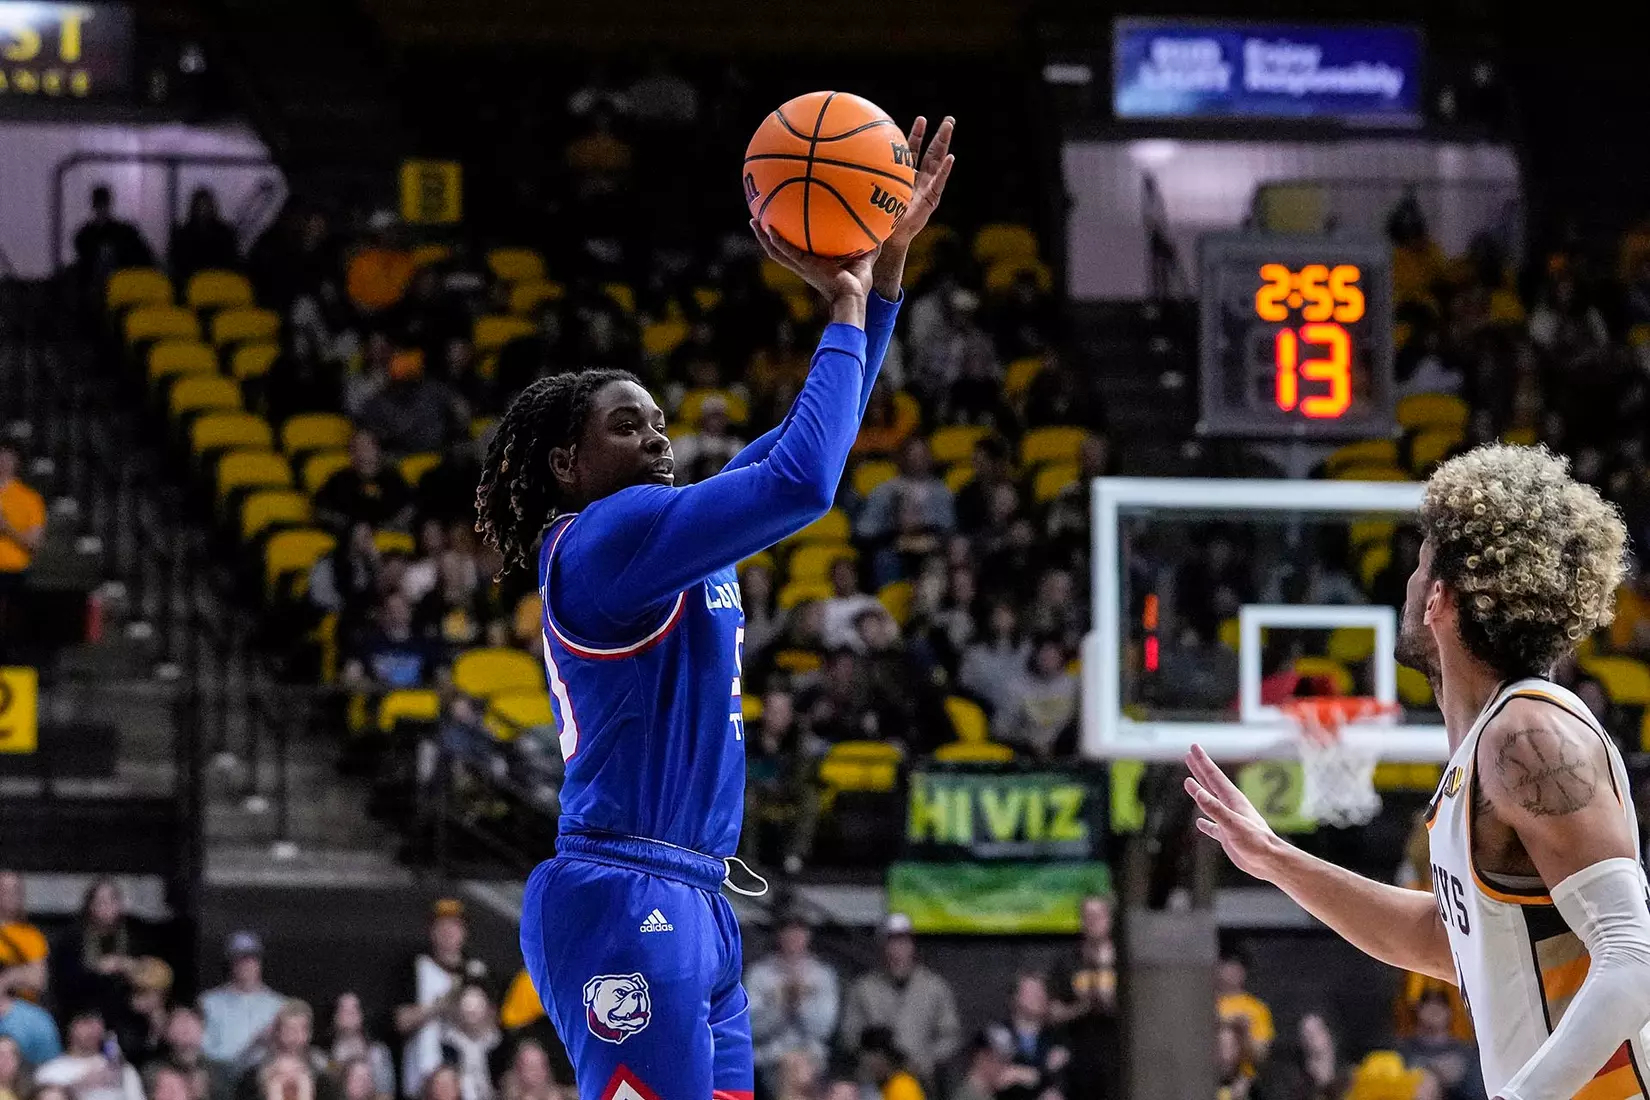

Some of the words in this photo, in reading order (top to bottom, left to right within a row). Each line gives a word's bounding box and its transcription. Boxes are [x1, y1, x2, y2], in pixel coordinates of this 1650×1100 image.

[1256, 263, 1365, 323] 2:55
[1275, 322, 1352, 419] 13
[640, 923, 674, 933] adidas
